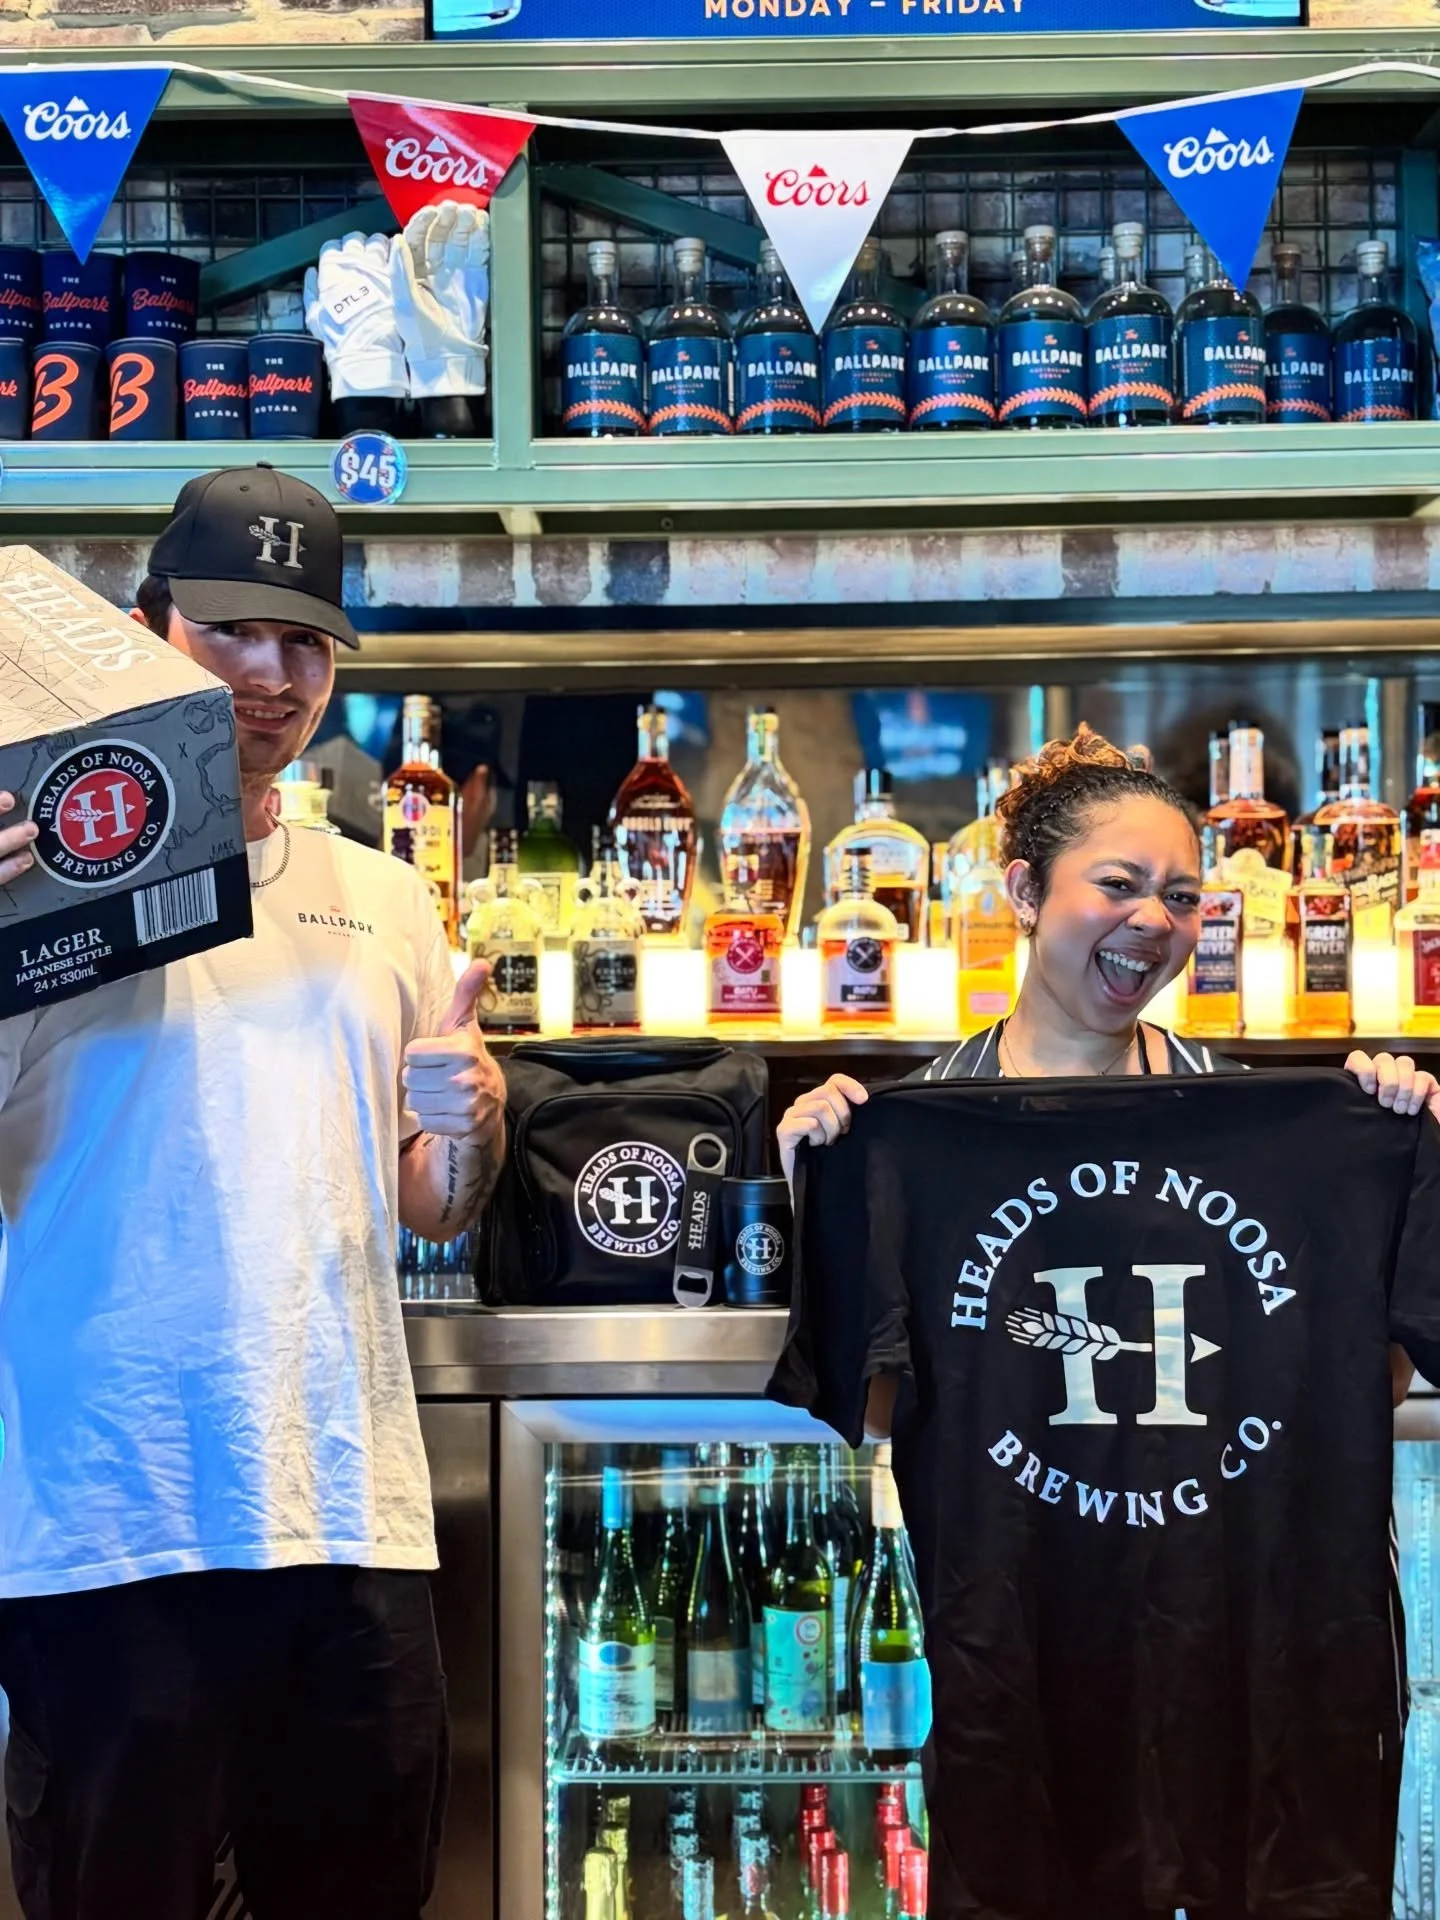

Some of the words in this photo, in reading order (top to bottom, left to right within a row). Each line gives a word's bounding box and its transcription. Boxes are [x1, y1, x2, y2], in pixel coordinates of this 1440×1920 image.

[704, 0, 851, 19] MONDAY
[901, 0, 1025, 15] FRIDAY
[23, 101, 132, 141] Coors
[385, 138, 489, 188] Coors
[1163, 136, 1275, 179] Coors
[765, 169, 871, 206] Coors
[62, 276, 80, 284] THE
[43, 290, 110, 313] Ballpark
[205, 363, 225, 371] THE
[264, 357, 284, 365] THE
[835, 354, 905, 372] BALLPARK
[918, 354, 989, 374] BALLPARK
[1012, 349, 1083, 367] BALLPARK
[1095, 343, 1168, 364] BALLPARK
[567, 361, 637, 379] BALLPARK
[652, 365, 720, 385] BALLPARK
[748, 360, 817, 378] BALLPARK
[1264, 361, 1325, 377] ALLPARK
[1344, 367, 1414, 385] BALLPARK
[109, 352, 155, 433] B
[248, 373, 314, 400] Ballpark
[340, 448, 397, 489] $45
[40, 765, 78, 819] HEADS
[81, 753, 104, 768] OF
[108, 752, 157, 791] NOOSA
[72, 781, 135, 848] H
[52, 850, 137, 877] BREWING
[298, 912, 374, 935] BALLPARK
[20, 928, 104, 968] LAGER
[16, 957, 75, 986] JAPANESE
[75, 945, 113, 965] STYLE
[34, 979, 49, 994] 24
[50, 978, 59, 990] x
[60, 963, 99, 985] 330mL
[580, 1152, 618, 1194] HEADS
[620, 1148, 640, 1160] OF
[642, 1149, 682, 1192] NOOSA
[688, 1191, 708, 1250] HEADS
[587, 1222, 658, 1253] BREWING
[950, 1177, 1059, 1331] HEADS
[1070, 1160, 1140, 1199] OF
[1155, 1167, 1297, 1316] NOOSA
[1030, 1264, 1210, 1426] H
[987, 1429, 1209, 1528] BREWING
